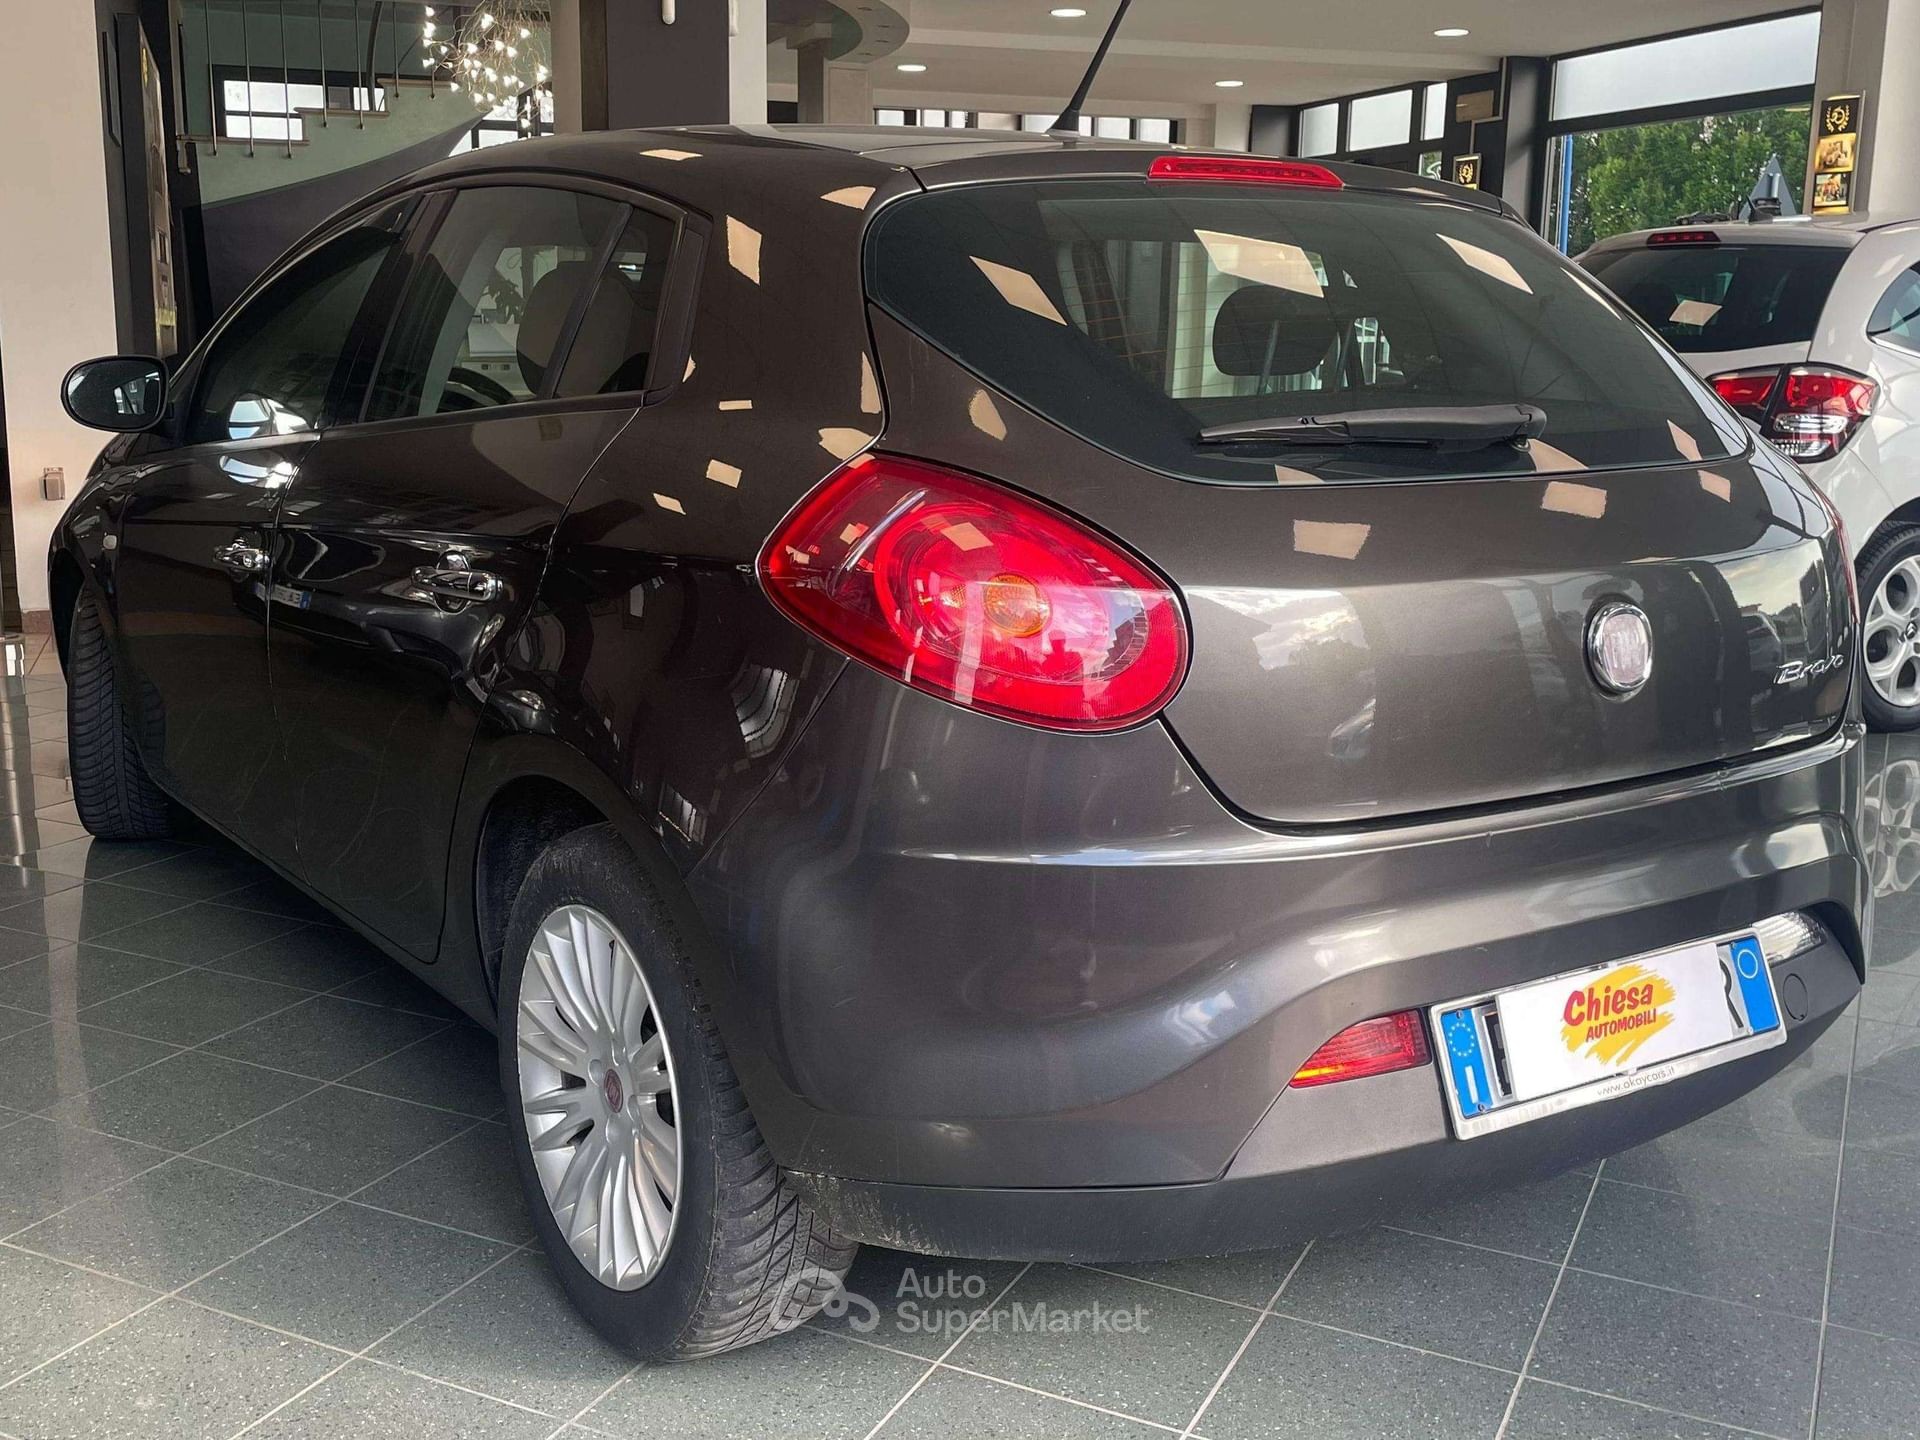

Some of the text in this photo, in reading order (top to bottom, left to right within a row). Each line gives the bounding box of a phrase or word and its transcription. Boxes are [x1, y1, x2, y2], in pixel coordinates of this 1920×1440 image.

[1775, 654, 1844, 684] Bravo
[1563, 983, 1654, 1026] Chiesa
[1585, 1008, 1657, 1042] AUTOMOBILI
